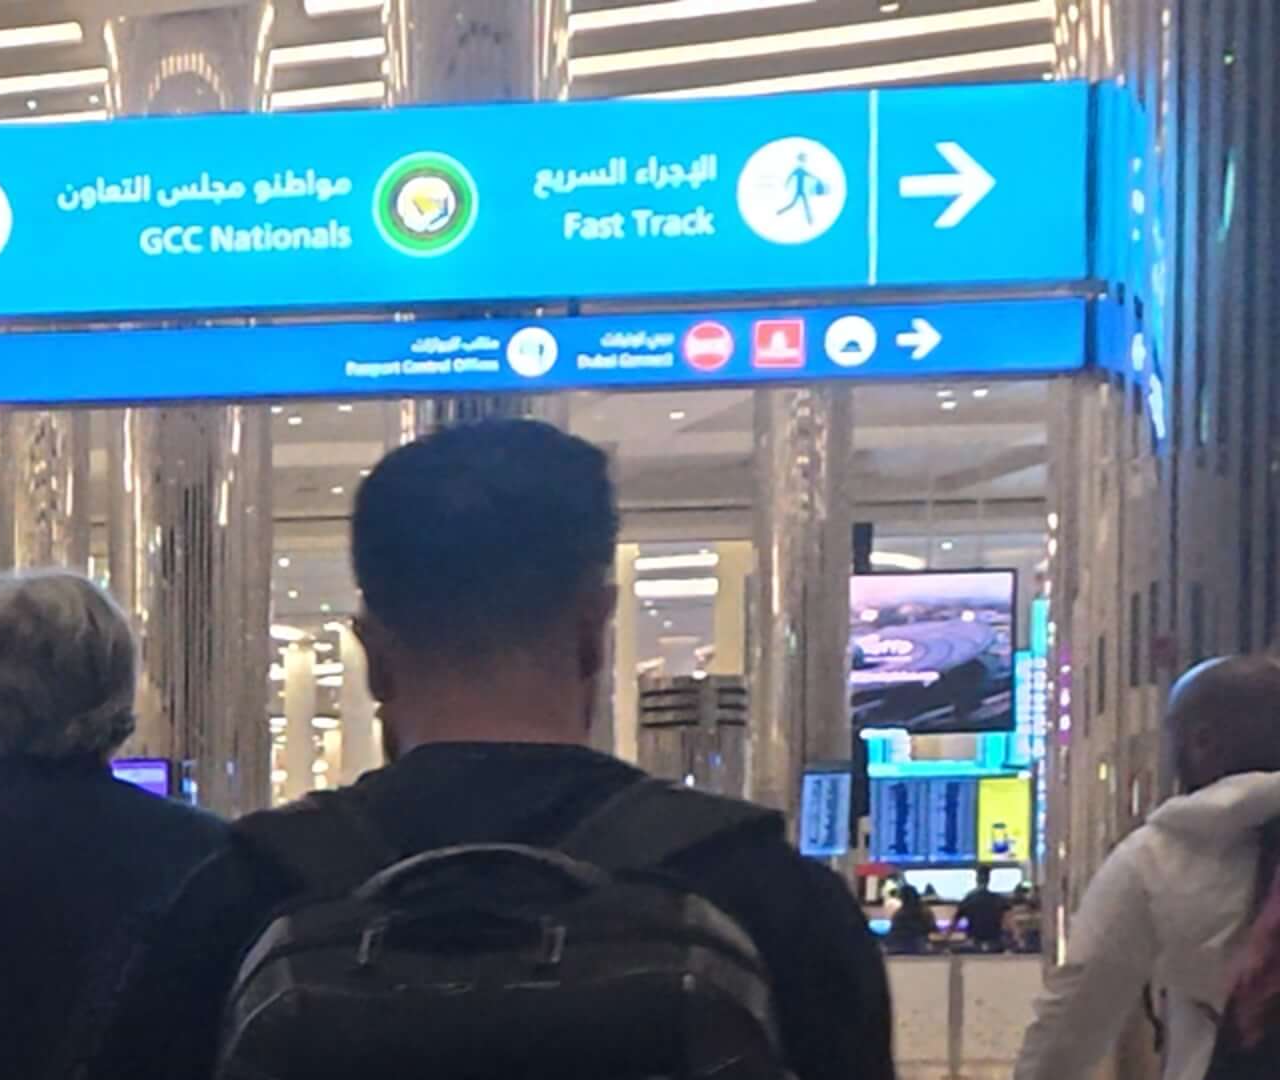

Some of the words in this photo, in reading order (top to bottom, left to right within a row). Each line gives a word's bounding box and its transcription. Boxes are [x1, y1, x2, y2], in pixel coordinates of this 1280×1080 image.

[253, 168, 354, 204] مواطنو
[533, 157, 627, 199] السريع
[634, 153, 718, 189] الإجراء
[56, 174, 152, 211] التعاون
[156, 172, 247, 208] مجلس
[139, 225, 203, 256] GCC
[209, 219, 353, 252] Nationals
[563, 211, 625, 240] Fast
[631, 206, 716, 237] Track
